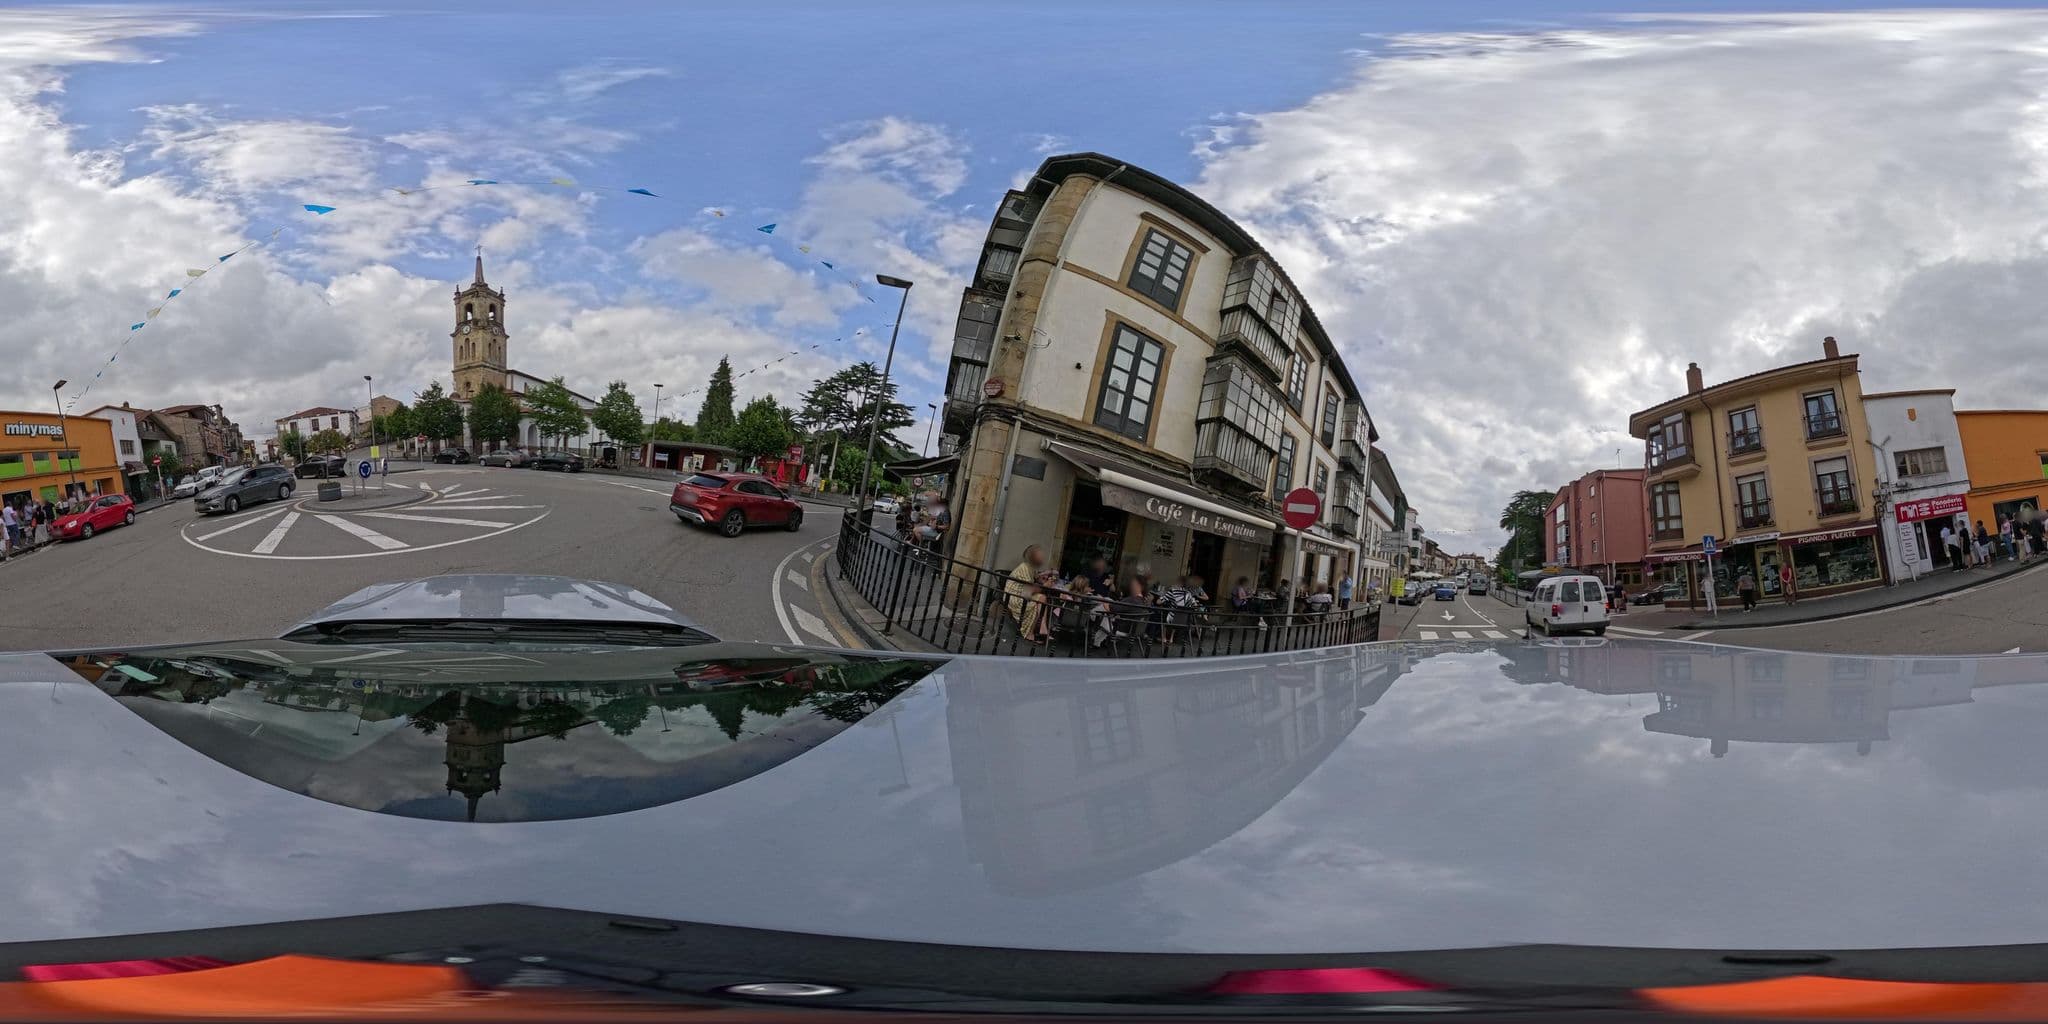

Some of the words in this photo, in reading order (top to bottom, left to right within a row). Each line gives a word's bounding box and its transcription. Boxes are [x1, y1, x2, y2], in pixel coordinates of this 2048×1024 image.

[6, 421, 63, 437] minymas
[1146, 497, 1183, 522] Café
[1190, 509, 1208, 527] La
[1215, 517, 1256, 538] Esquina
[1798, 534, 1828, 544] PISANDO
[1831, 530, 1857, 540] FUERTE
